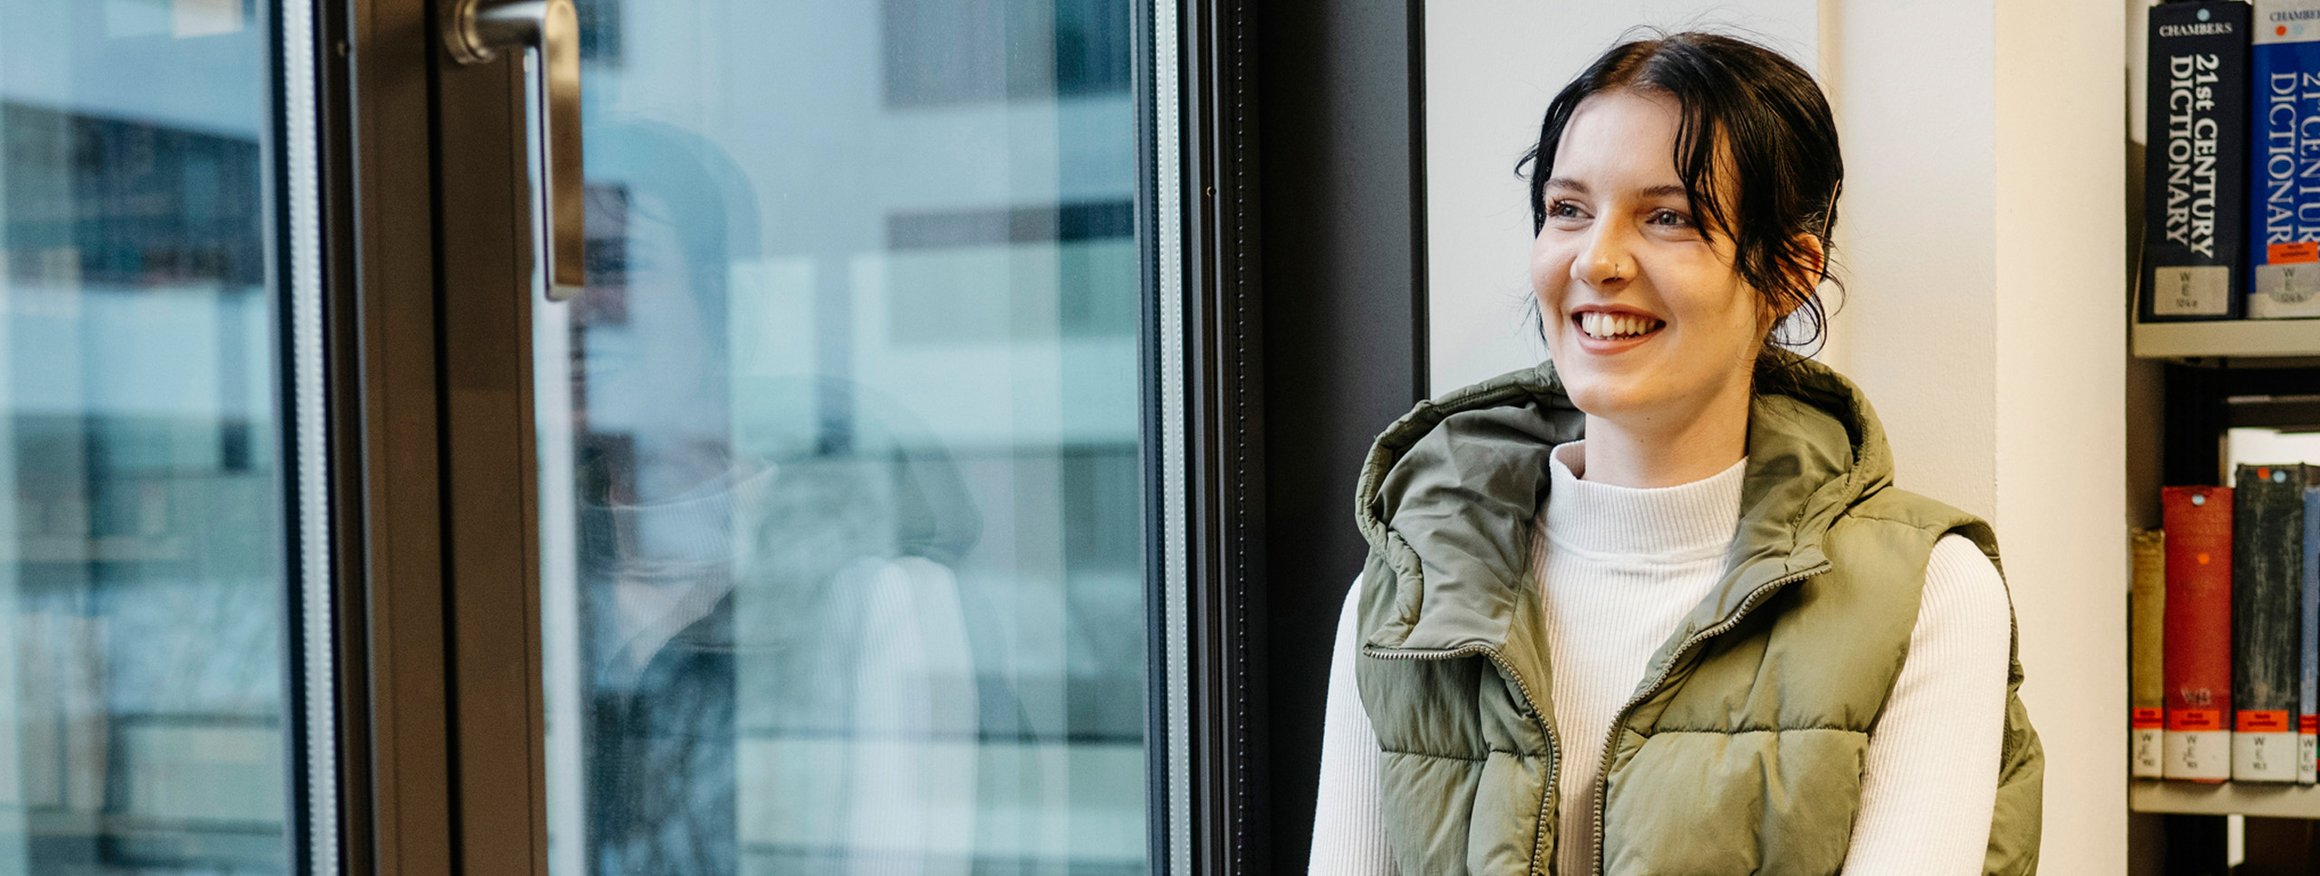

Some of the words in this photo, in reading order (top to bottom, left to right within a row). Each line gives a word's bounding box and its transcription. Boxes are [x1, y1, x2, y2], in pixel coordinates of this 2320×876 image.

[2159, 22, 2233, 38] CHAMBERS
[2195, 53, 2220, 111] 21st
[2166, 55, 2194, 247] DICTIONARY
[2190, 118, 2219, 259] CENTURY
[2267, 71, 2298, 245] DICTIONAR
[2297, 115, 2320, 245] CENTUR
